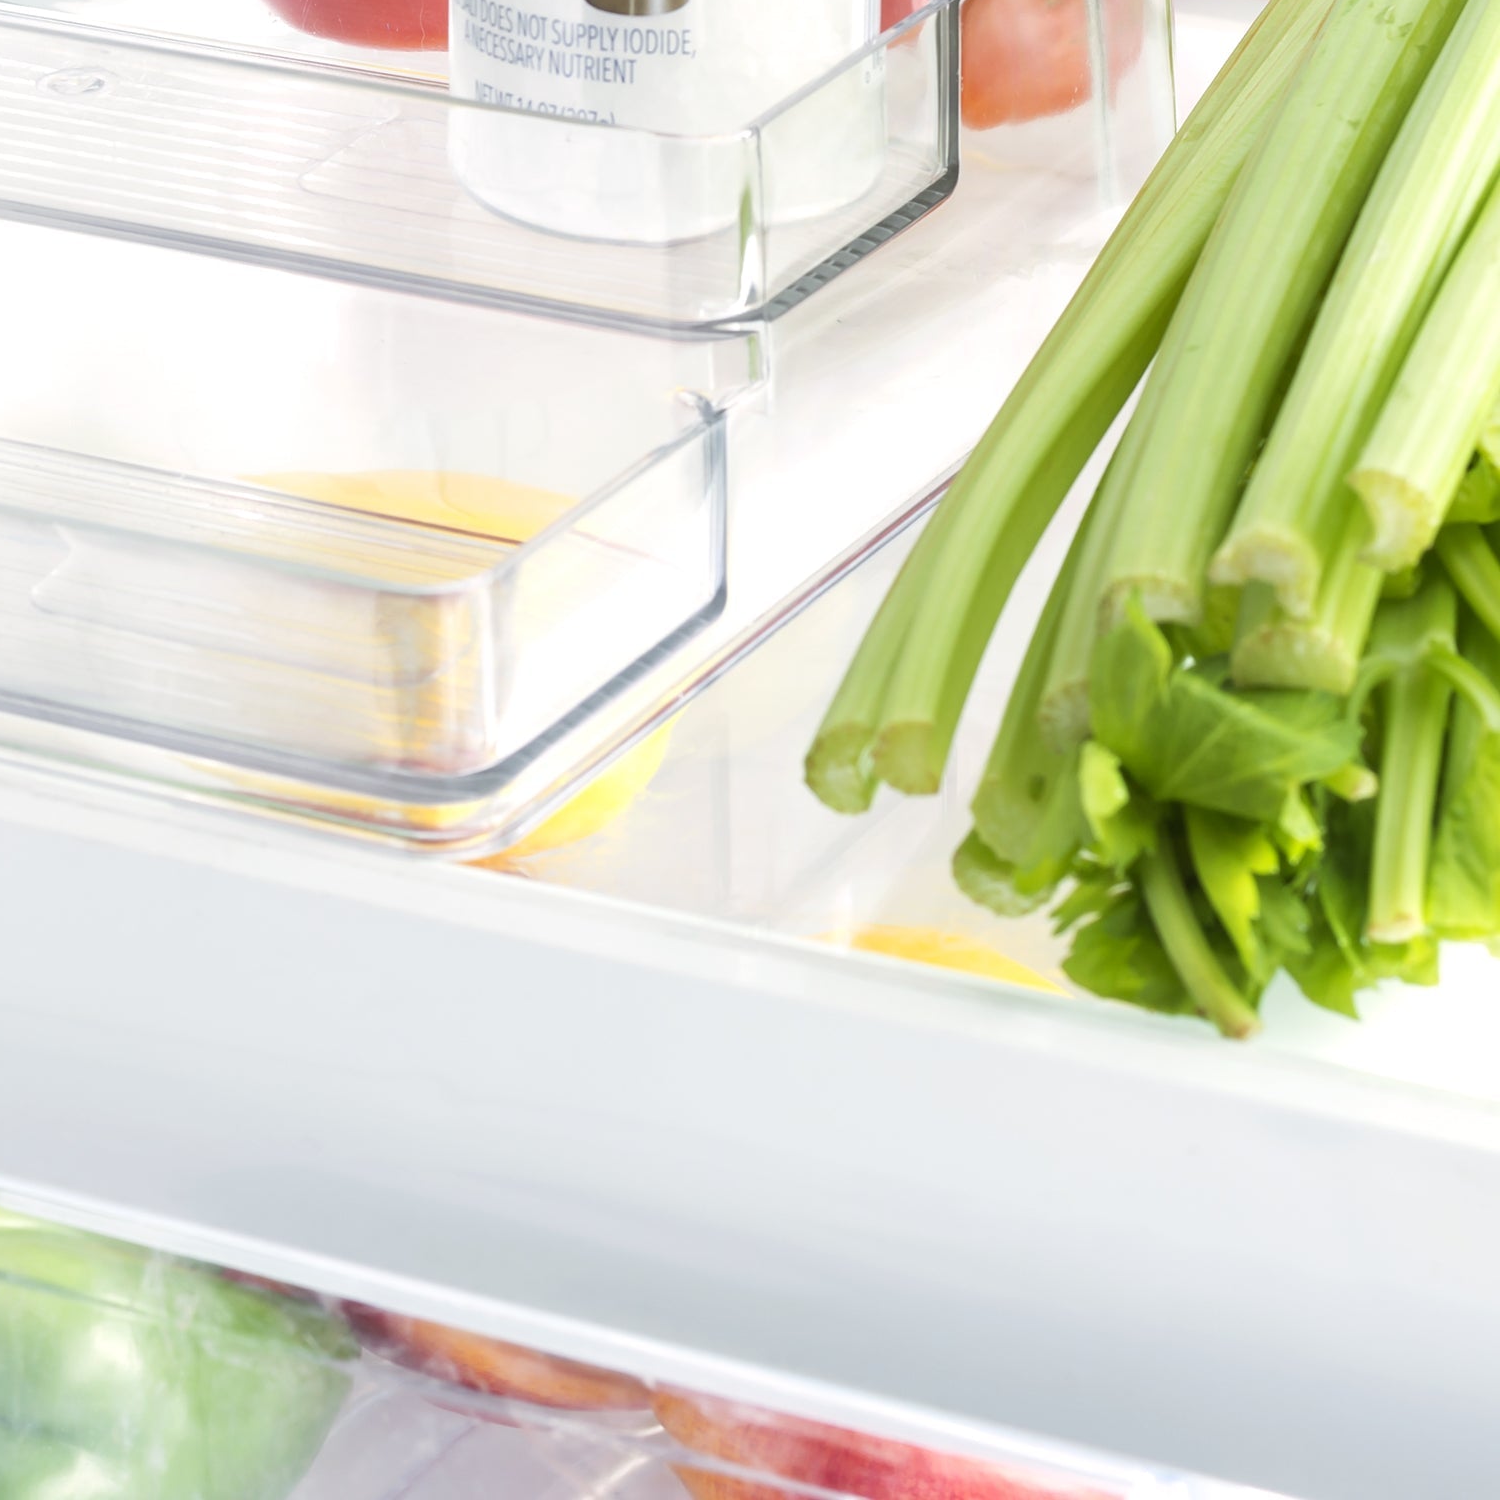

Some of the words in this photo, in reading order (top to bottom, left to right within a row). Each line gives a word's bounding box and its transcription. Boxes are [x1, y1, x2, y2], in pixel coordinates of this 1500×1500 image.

[471, 21, 545, 72] NECESSARY
[548, 48, 638, 85] NUTRIENT
[517, 11, 548, 42] NOT
[551, 18, 619, 53] SUPPLY
[624, 27, 697, 59] IODIDE,
